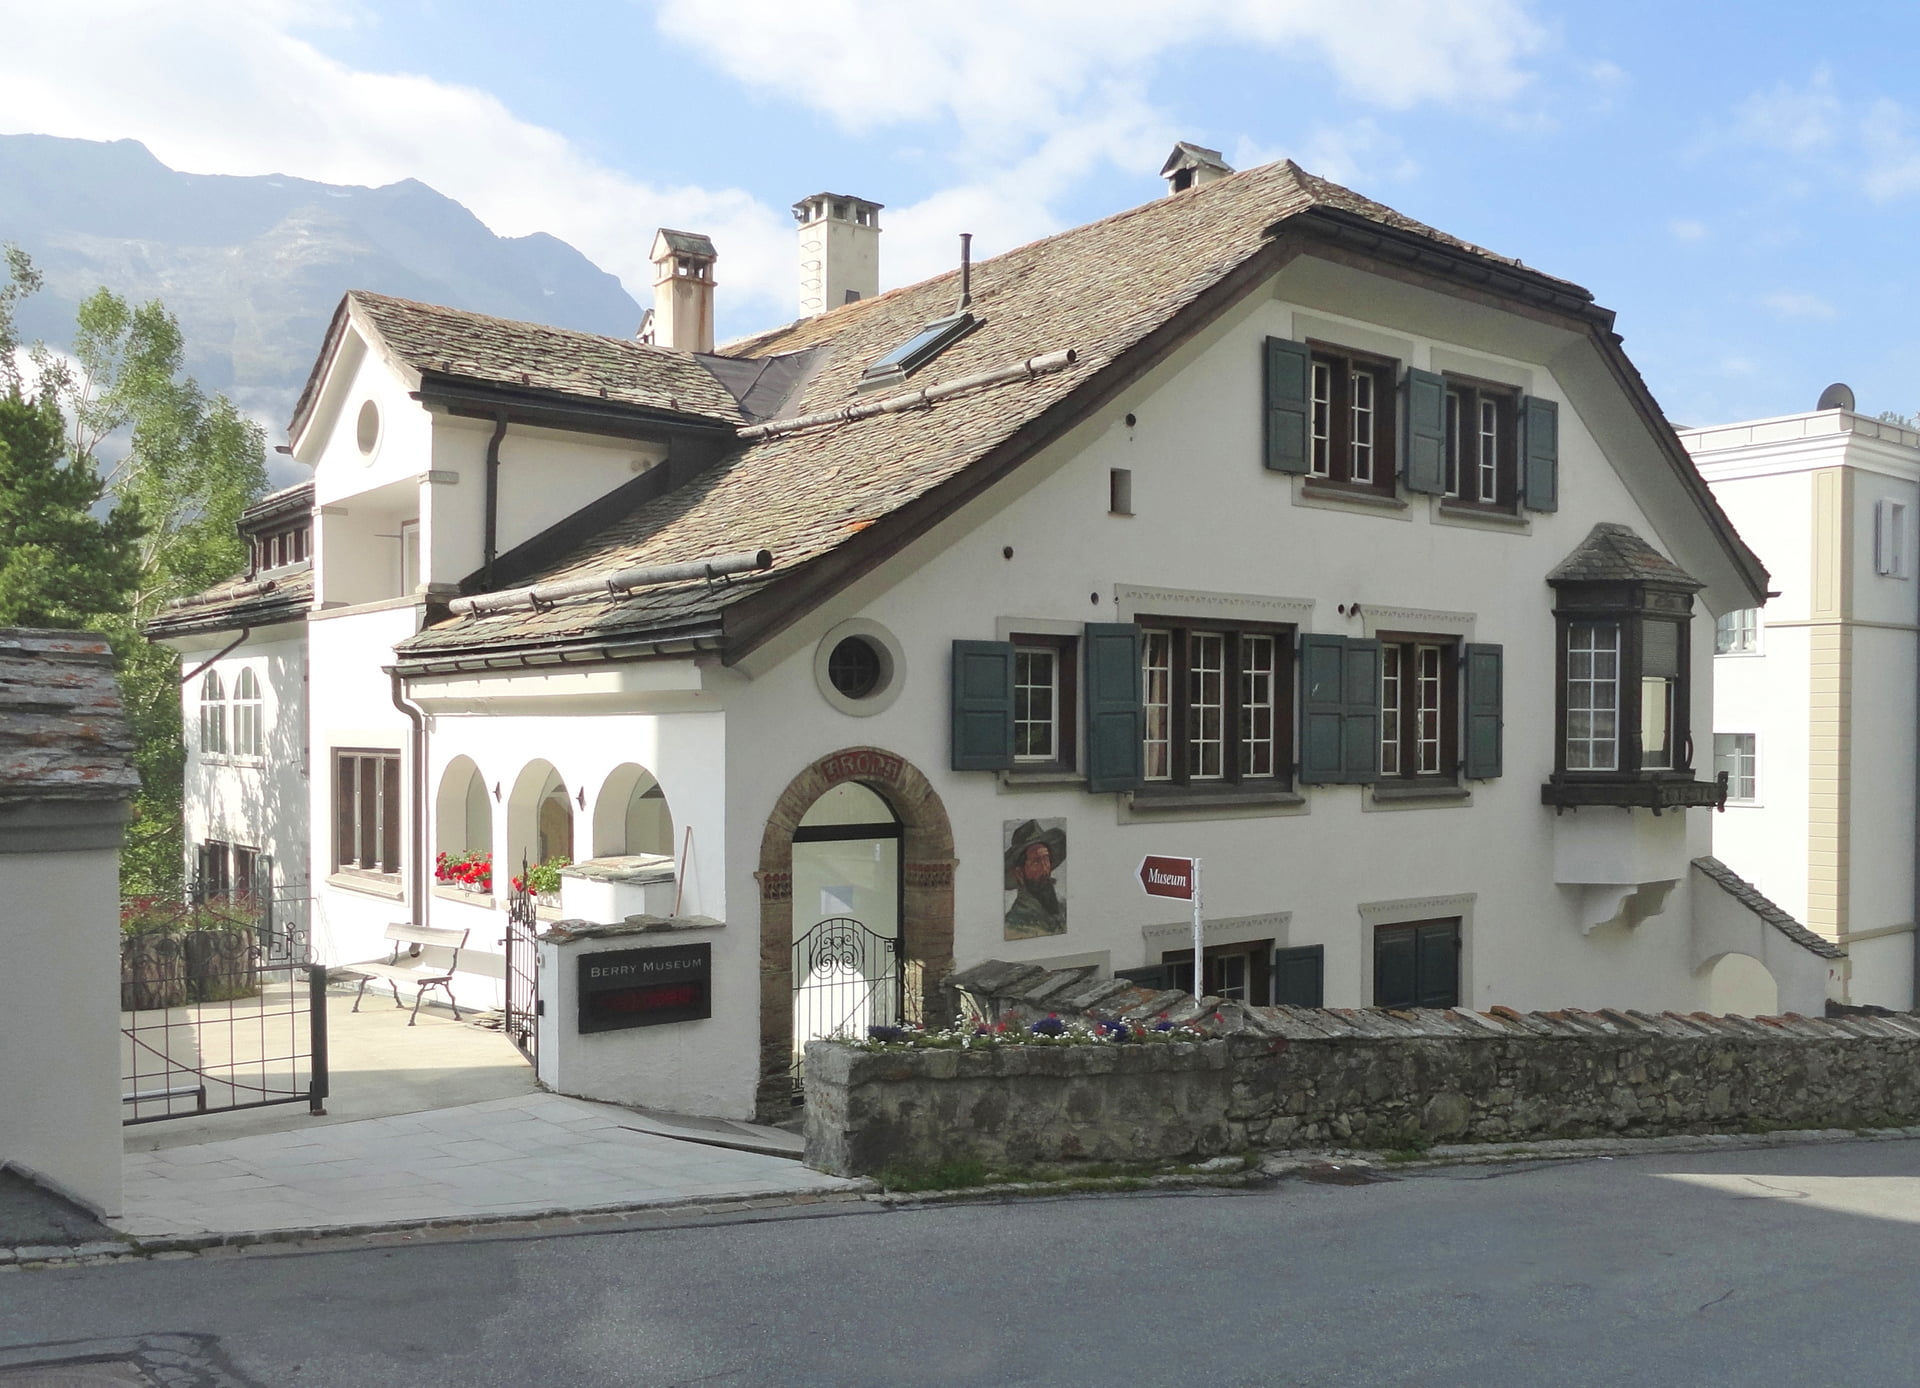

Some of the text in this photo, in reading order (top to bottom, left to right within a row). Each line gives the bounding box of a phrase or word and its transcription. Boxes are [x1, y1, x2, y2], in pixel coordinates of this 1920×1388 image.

[1148, 867, 1187, 887] Museum
[591, 958, 702, 978] BERRY MUSEUM
